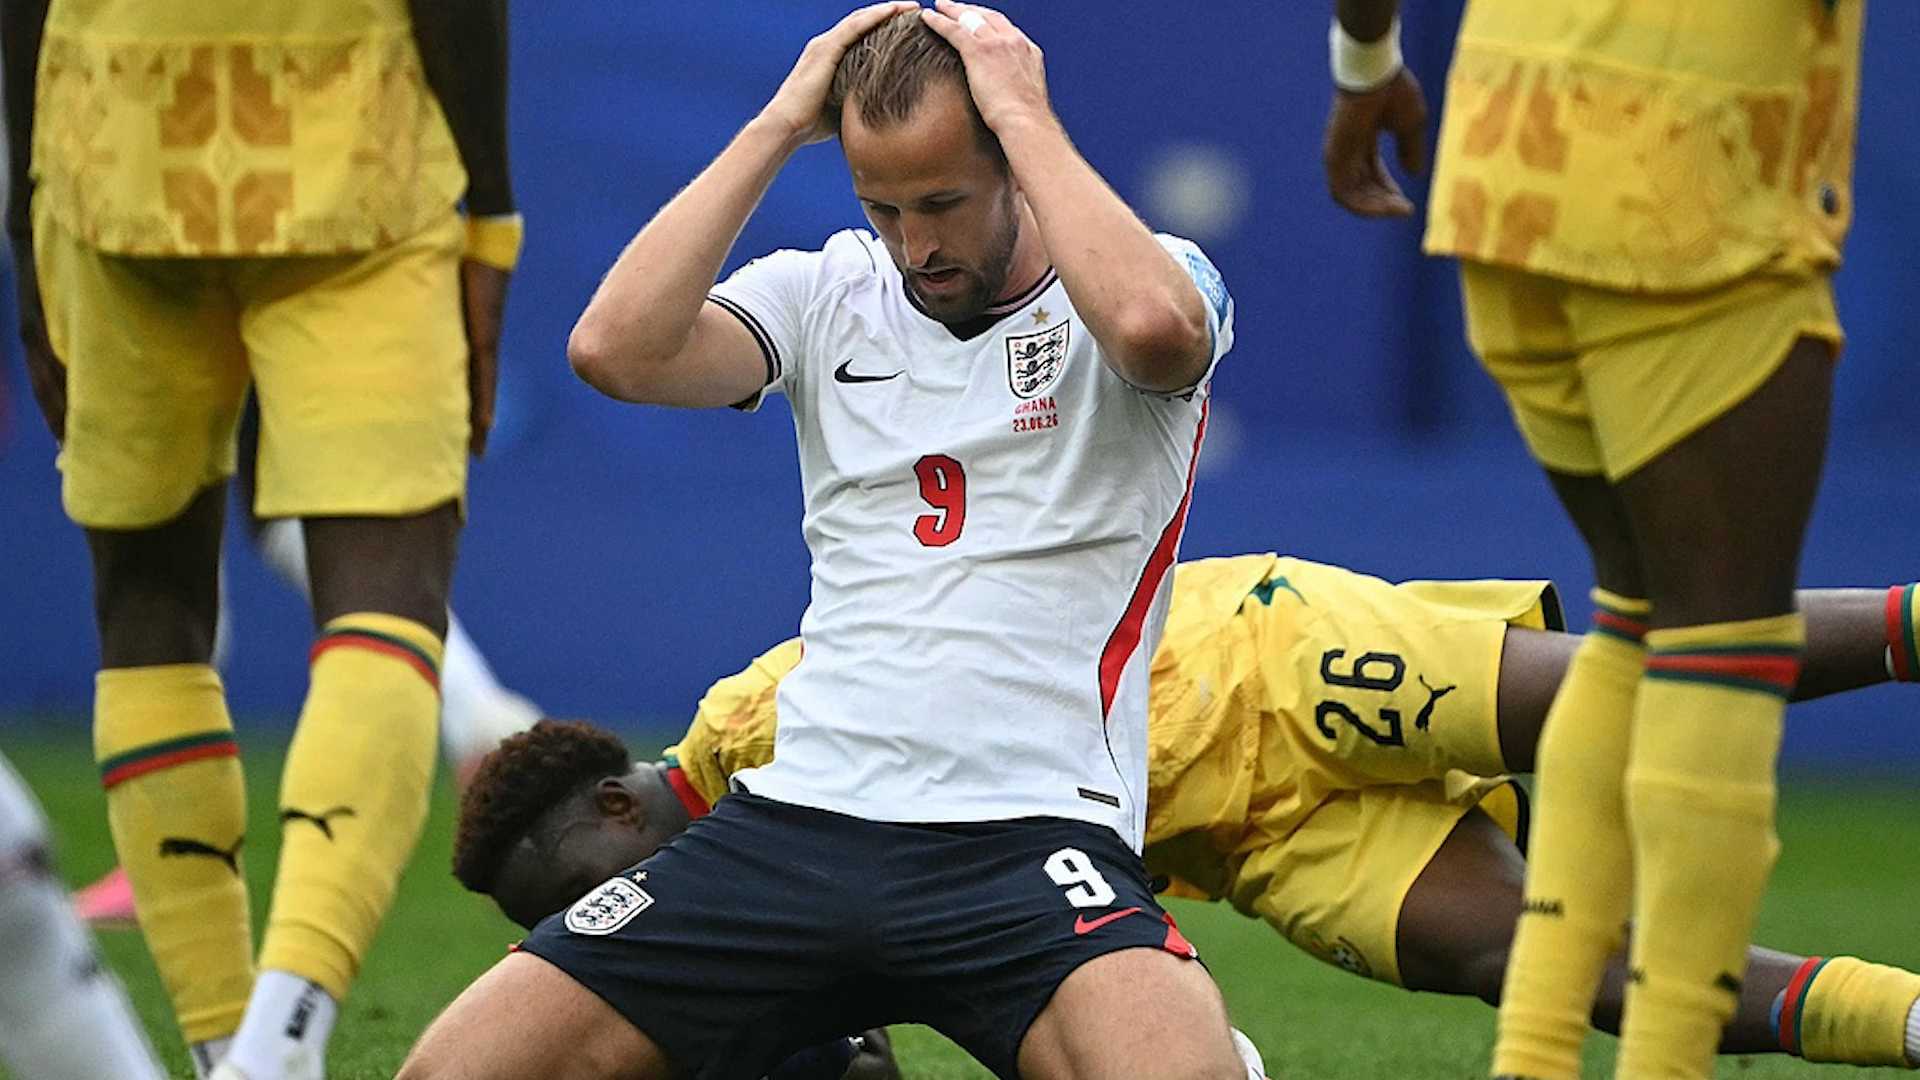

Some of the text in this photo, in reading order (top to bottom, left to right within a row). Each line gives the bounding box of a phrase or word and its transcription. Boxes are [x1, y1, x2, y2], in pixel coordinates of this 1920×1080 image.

[1013, 413, 1058, 432] 23.06.26
[1015, 397, 1056, 414] GHANA
[913, 454, 966, 547] 9
[1315, 649, 1405, 746] 26
[1042, 847, 1116, 908] 9
